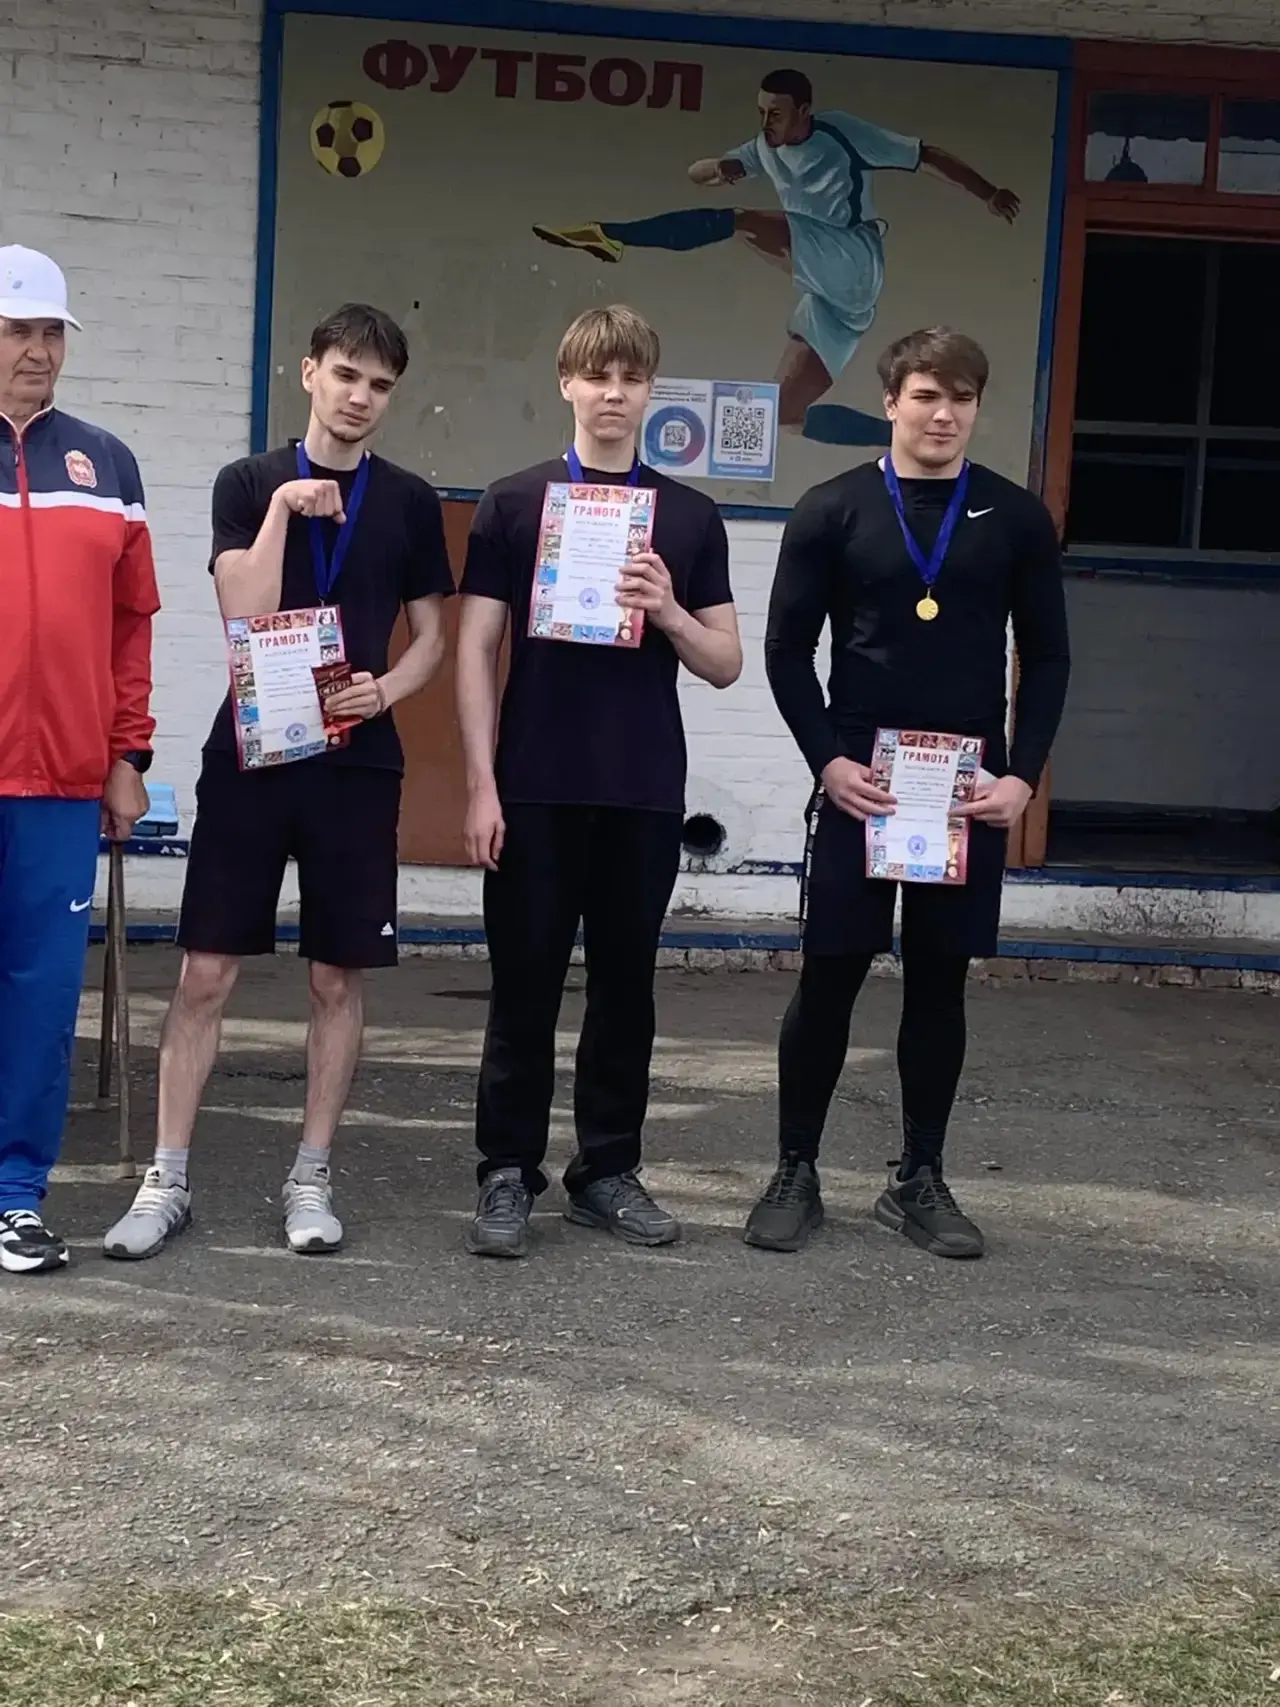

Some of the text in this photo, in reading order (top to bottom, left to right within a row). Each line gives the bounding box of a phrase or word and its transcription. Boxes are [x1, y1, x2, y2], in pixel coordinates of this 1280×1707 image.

[362, 39, 704, 112] ФУТБОЛ
[573, 505, 621, 519] ГРАМОТА
[258, 633, 309, 648] ГРАМОТА
[902, 750, 949, 764] ГРАМОТА
